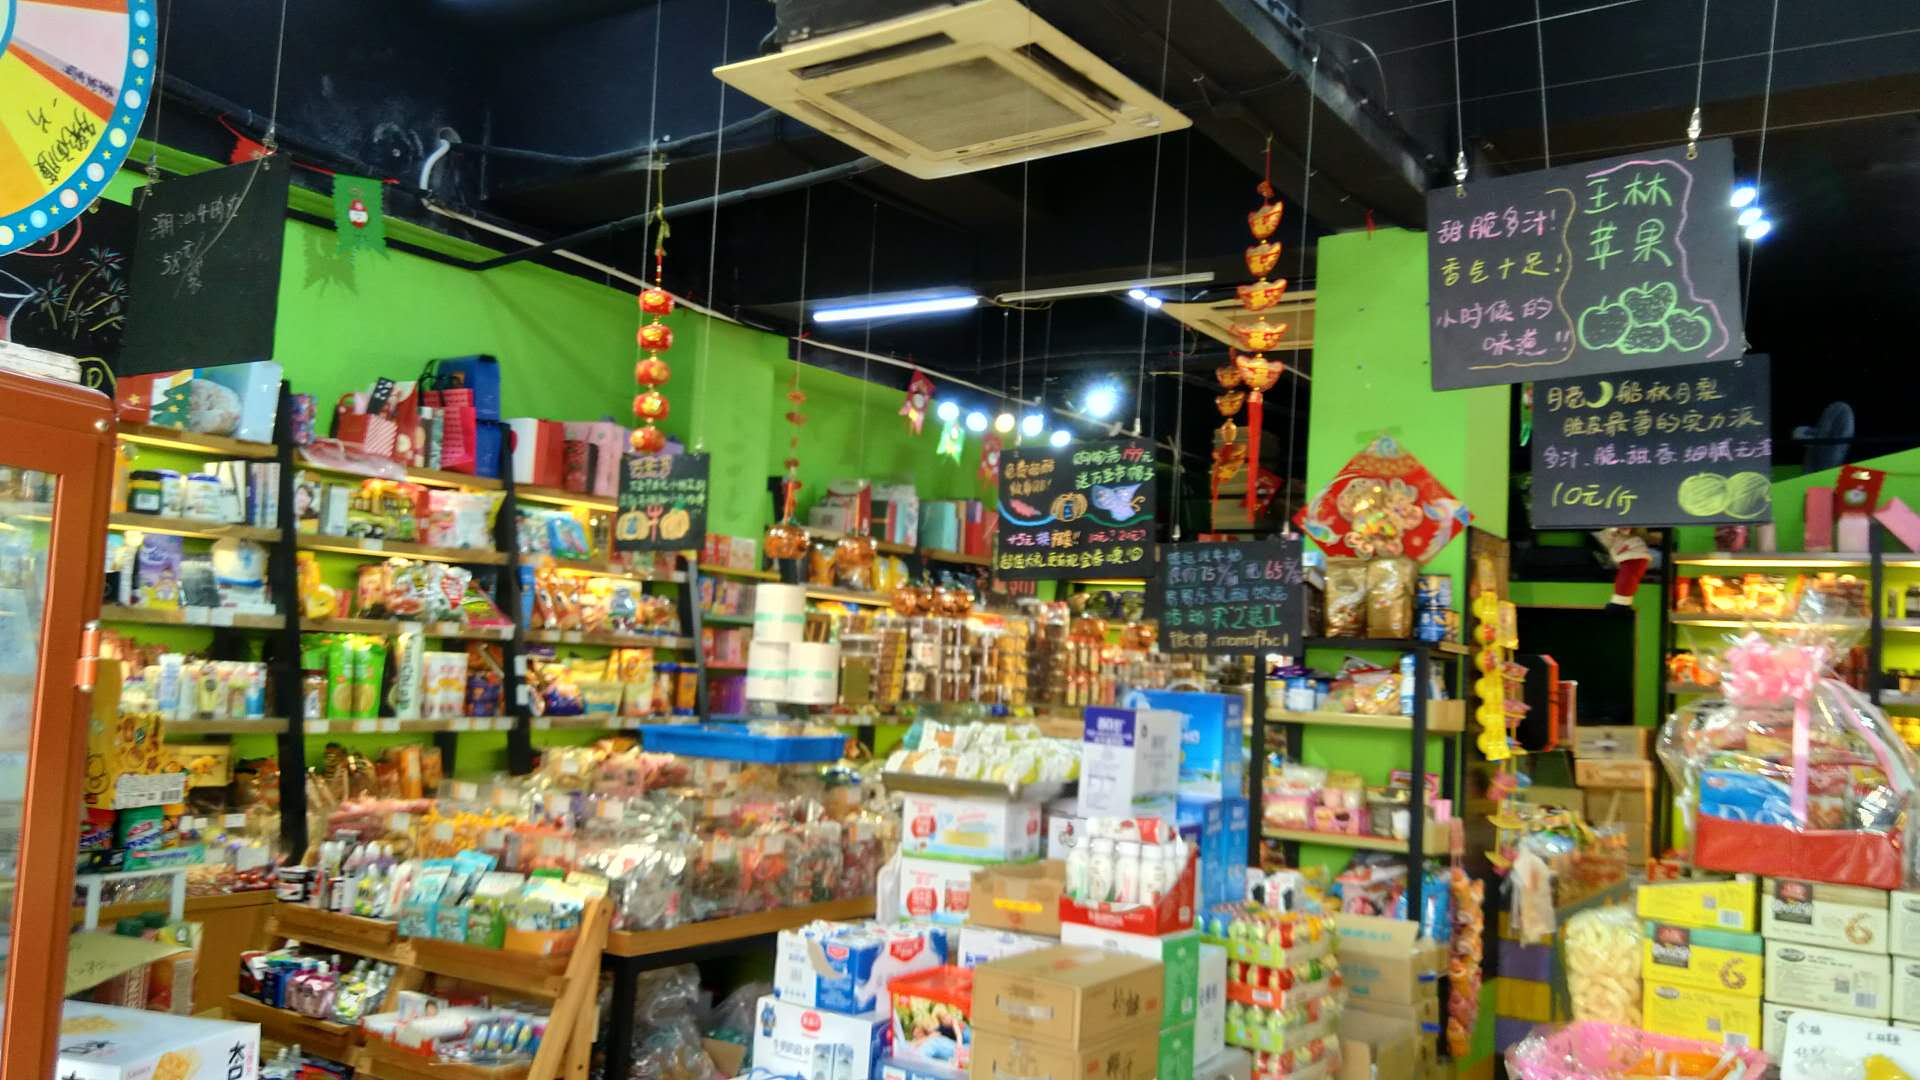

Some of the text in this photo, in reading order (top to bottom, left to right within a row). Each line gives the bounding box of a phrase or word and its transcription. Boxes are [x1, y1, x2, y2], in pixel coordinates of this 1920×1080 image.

[1584, 171, 1673, 215] 王林
[1437, 205, 1557, 244] 甜脆多汁!
[1585, 219, 1673, 270] 苹果
[1440, 251, 1563, 287] 香气十足!
[1436, 296, 1553, 329] 小时候的
[1551, 481, 1640, 516] 10元/斤
